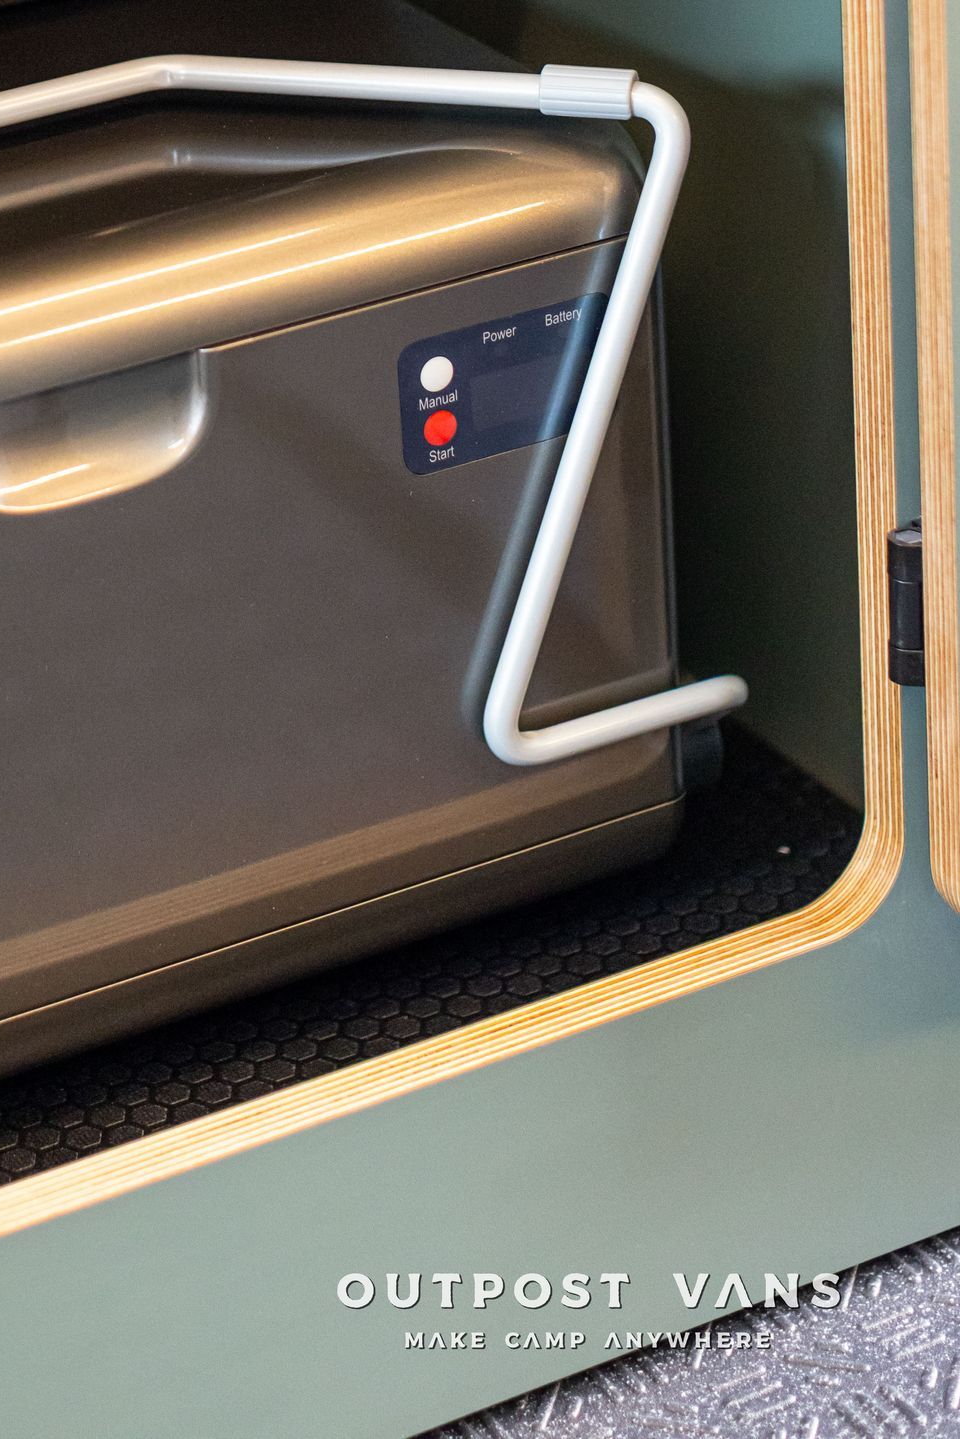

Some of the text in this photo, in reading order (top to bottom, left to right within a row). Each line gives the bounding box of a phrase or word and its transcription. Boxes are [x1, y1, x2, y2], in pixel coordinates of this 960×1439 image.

[545, 307, 583, 327] Battery
[482, 326, 517, 344] Power
[419, 390, 458, 410] Manual
[428, 446, 455, 463] Start
